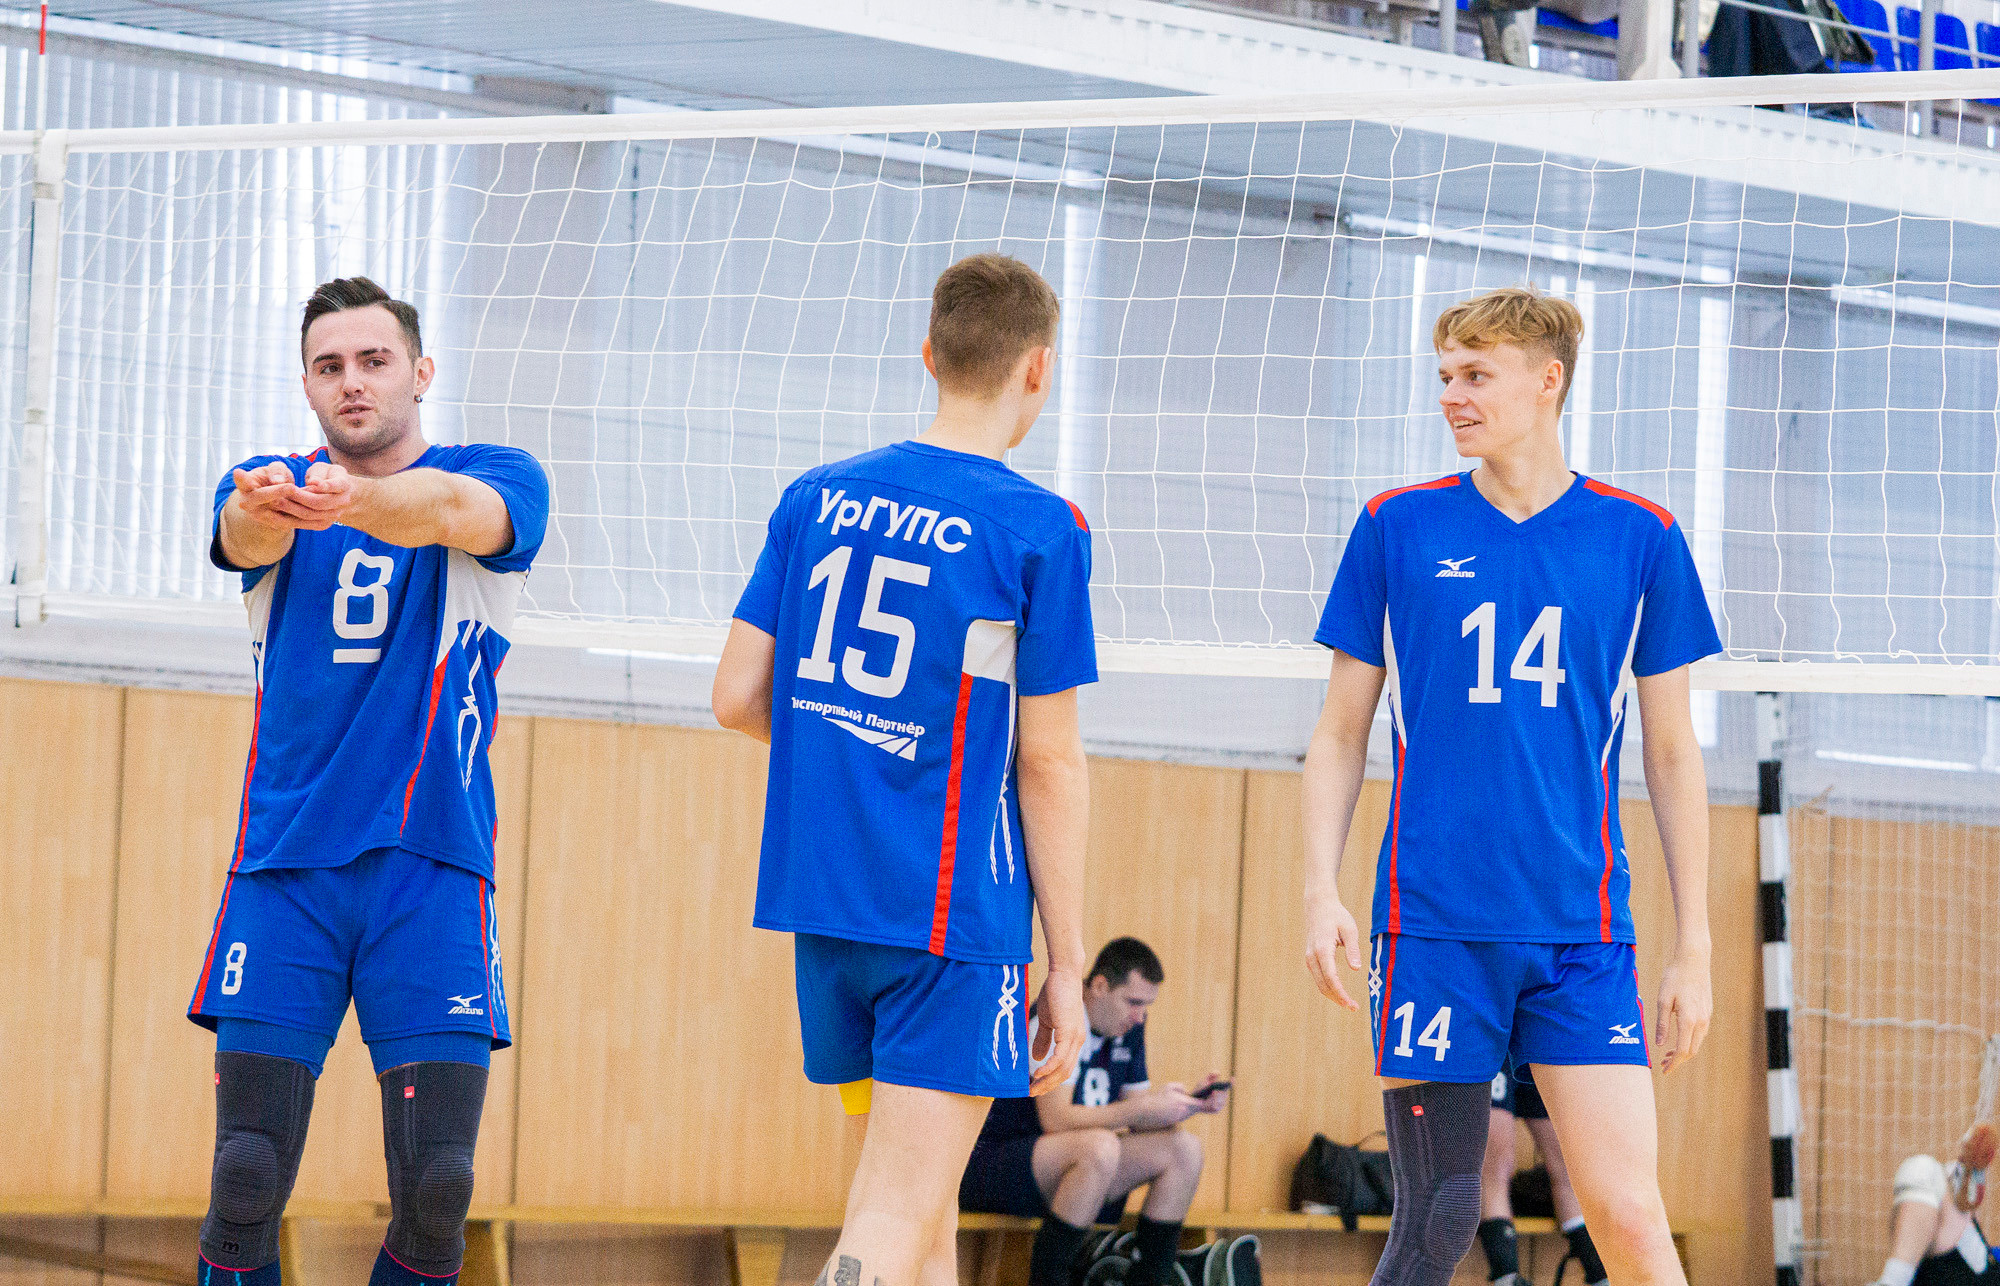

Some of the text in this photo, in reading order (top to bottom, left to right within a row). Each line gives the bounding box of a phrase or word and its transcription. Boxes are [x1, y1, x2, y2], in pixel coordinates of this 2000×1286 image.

[816, 488, 972, 553] УрГУПС
[332, 548, 394, 639] 8
[796, 545, 931, 698] 15
[1461, 601, 1566, 708] 14
[791, 696, 863, 723] нспортный
[221, 942, 247, 995] 8
[1394, 1001, 1452, 1062] 14
